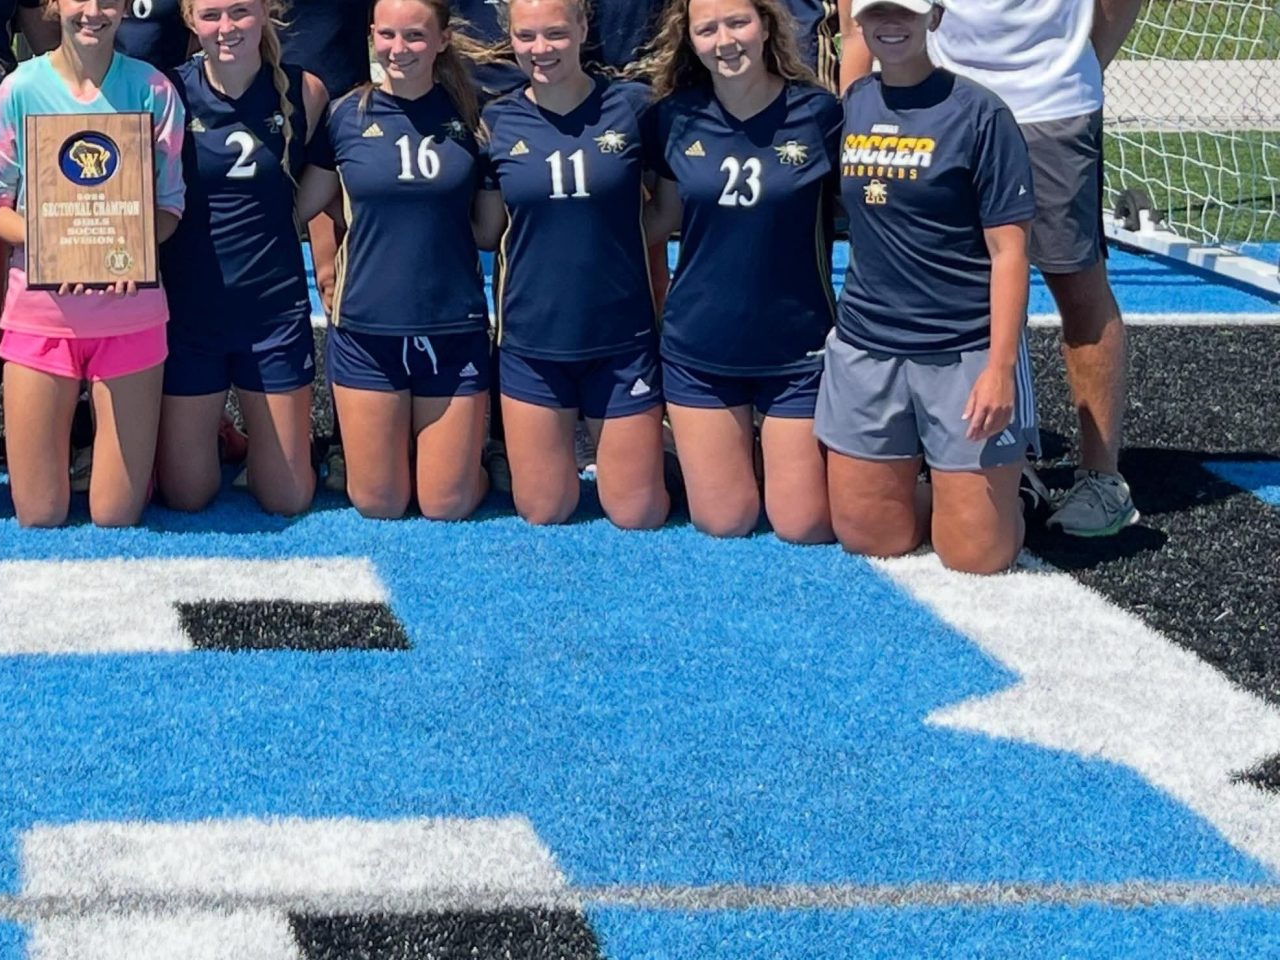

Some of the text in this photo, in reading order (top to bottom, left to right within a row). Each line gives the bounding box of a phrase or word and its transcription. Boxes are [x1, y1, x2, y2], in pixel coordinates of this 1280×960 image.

[225, 132, 256, 177] 2
[396, 135, 440, 180] 16
[842, 134, 936, 168] SOCCER
[546, 149, 589, 198] 11
[719, 157, 761, 205] 23
[41, 200, 140, 218] SECTIONAL CHAMPION
[60, 236, 114, 245] DIVISION
[67, 227, 116, 236] SOCCER
